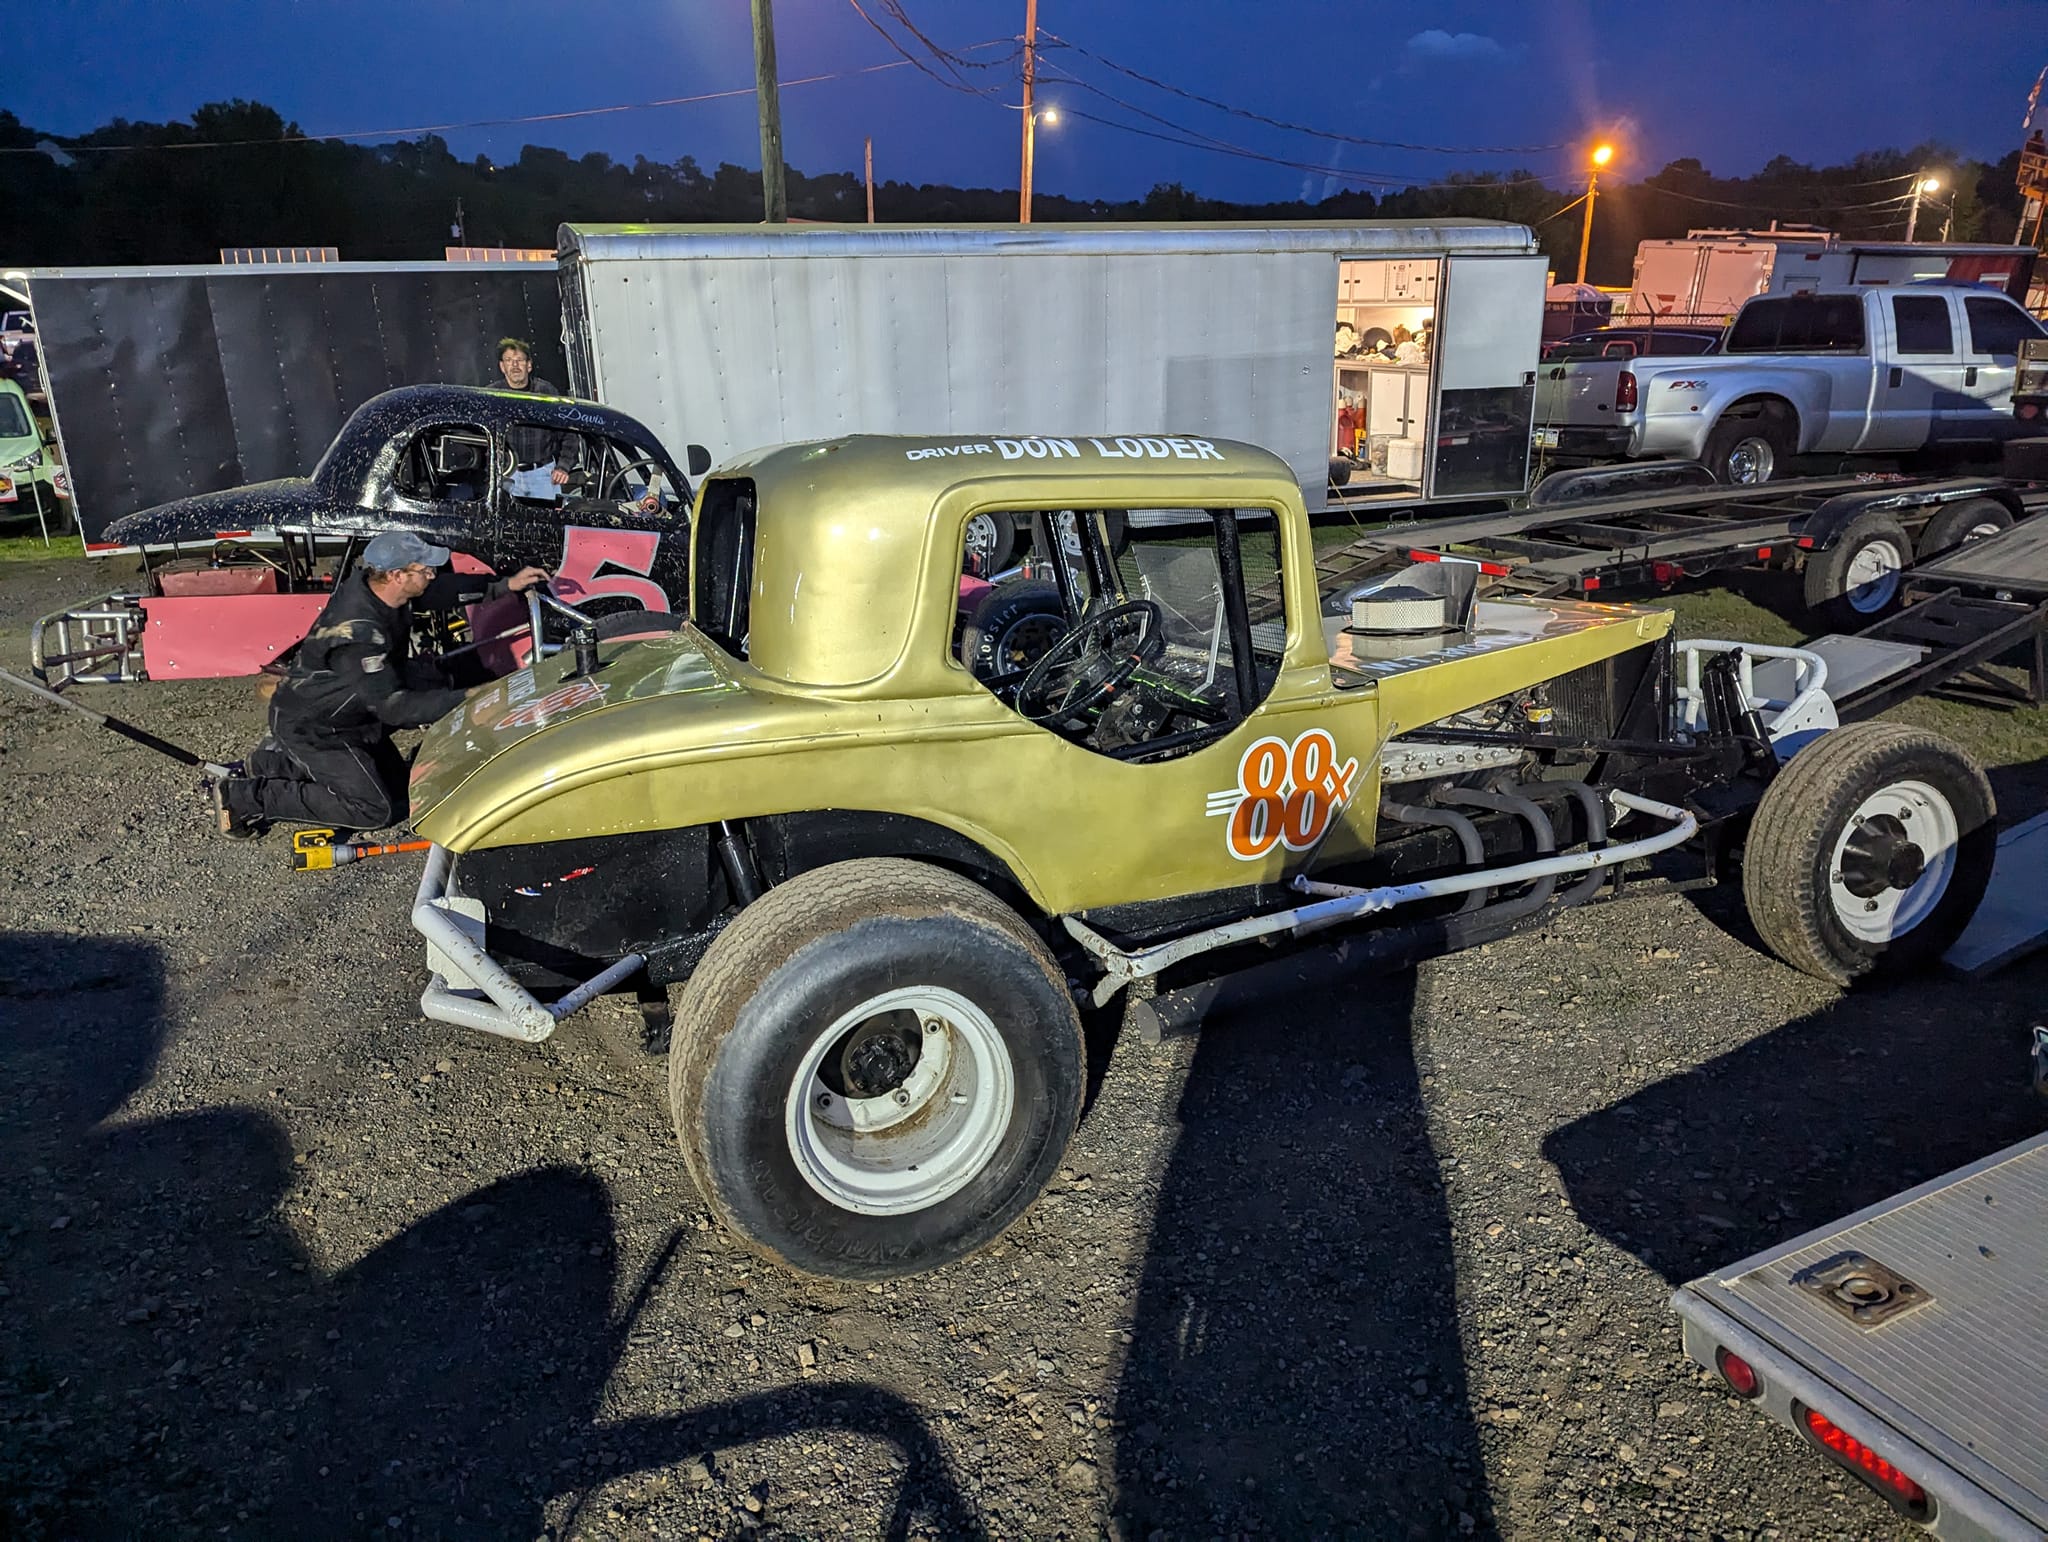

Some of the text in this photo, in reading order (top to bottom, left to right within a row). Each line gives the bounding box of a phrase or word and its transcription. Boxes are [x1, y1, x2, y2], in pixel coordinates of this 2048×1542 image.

[558, 406, 606, 425] Davis
[905, 437, 1225, 461] DRIVER DON LODER
[546, 525, 671, 615] 5
